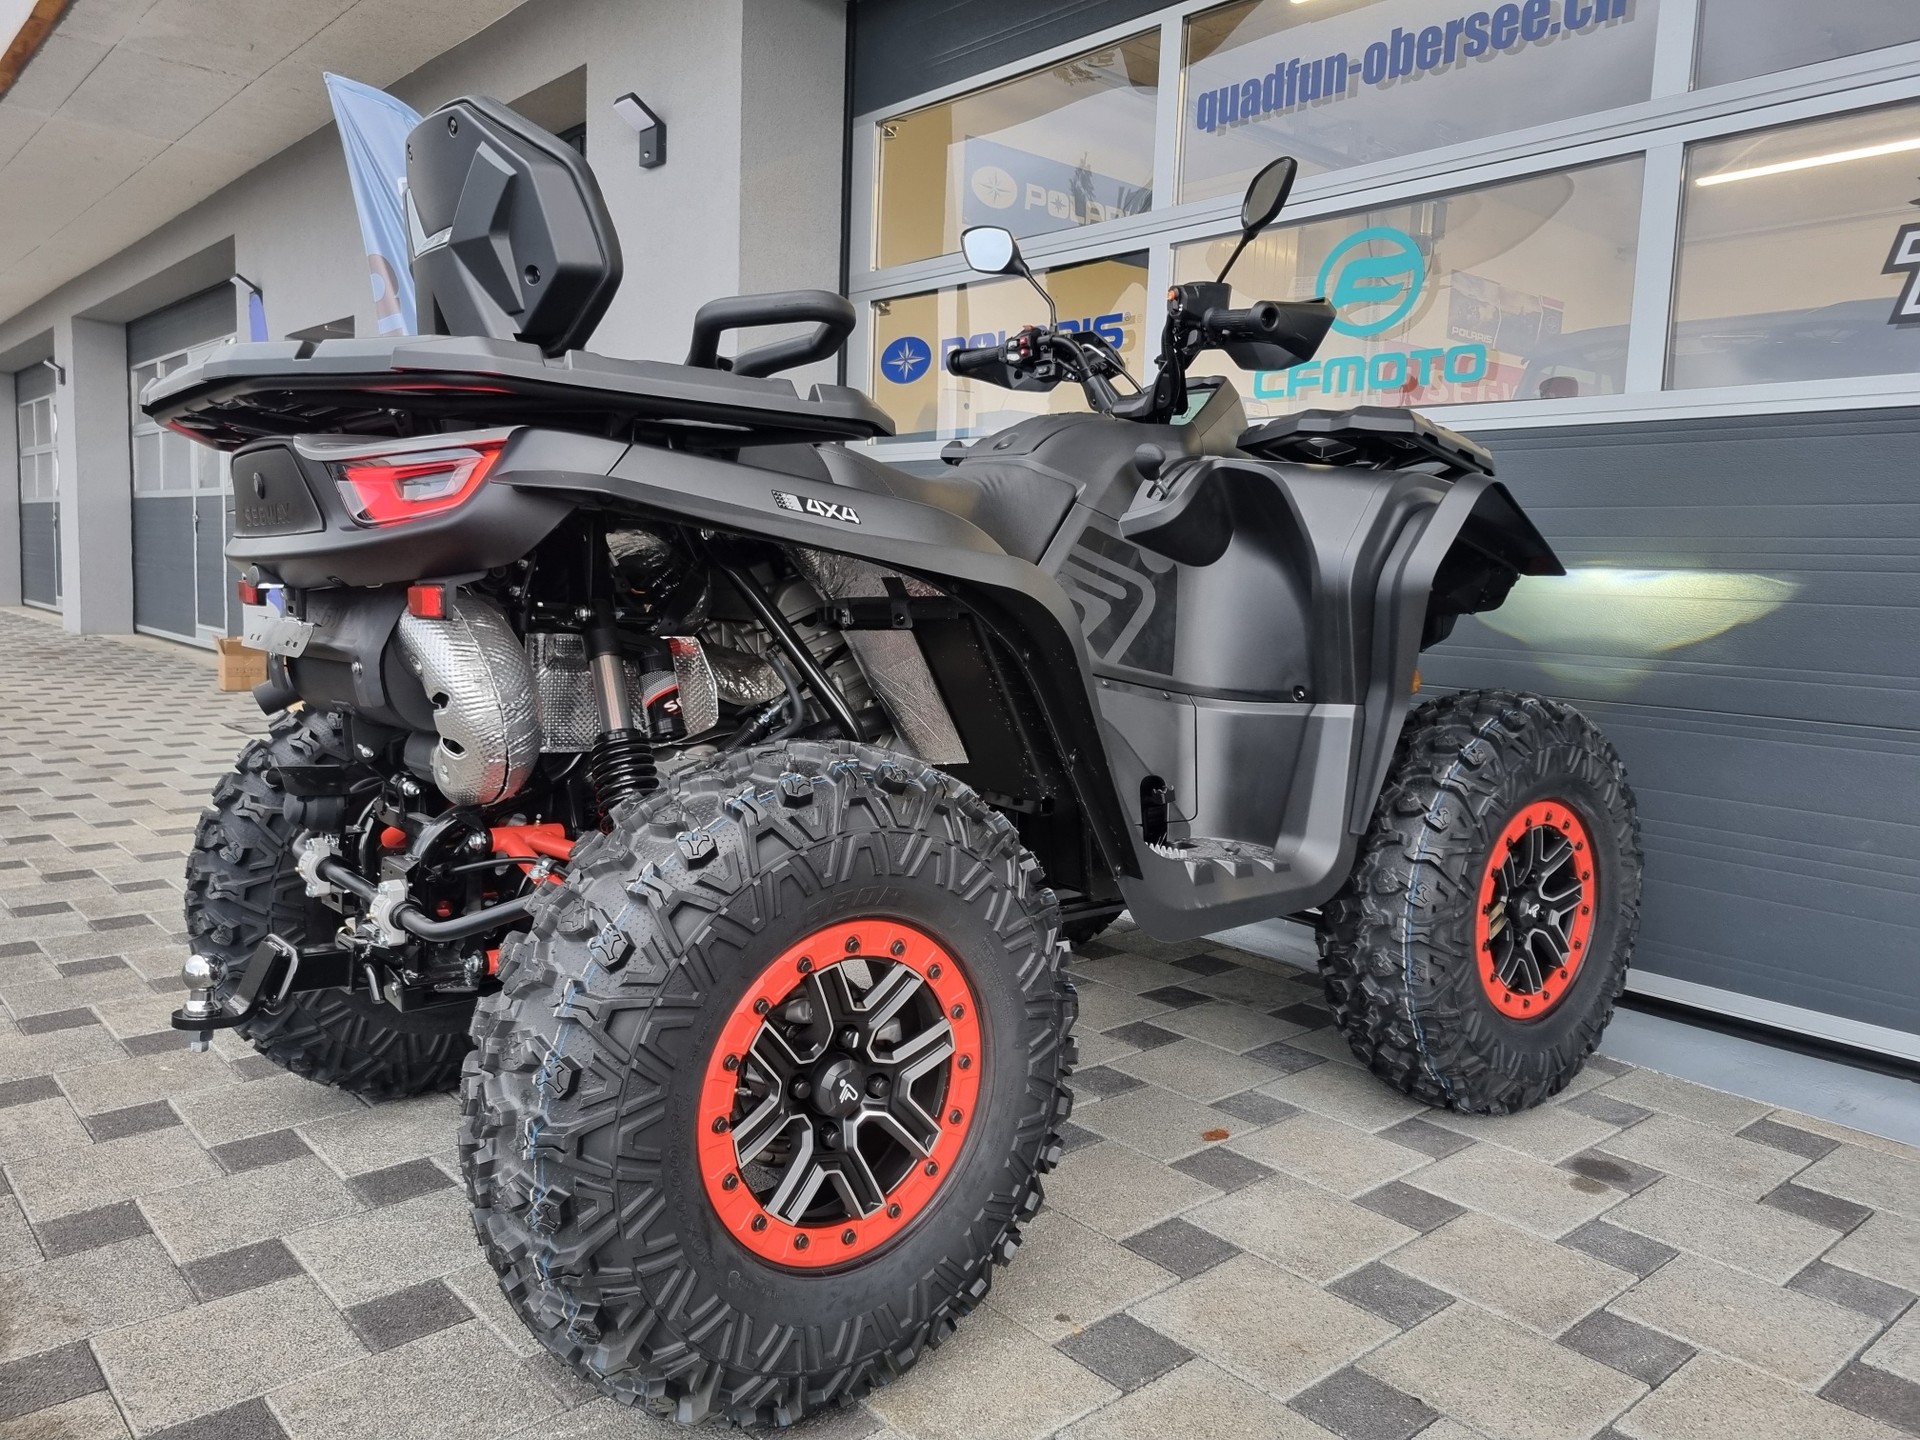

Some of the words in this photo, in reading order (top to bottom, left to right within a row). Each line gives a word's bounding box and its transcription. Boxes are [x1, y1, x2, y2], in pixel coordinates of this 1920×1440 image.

[1452, 326, 1493, 344] POLARIS
[1253, 343, 1488, 400] CFMOTO
[244, 503, 291, 527] SEGWAY
